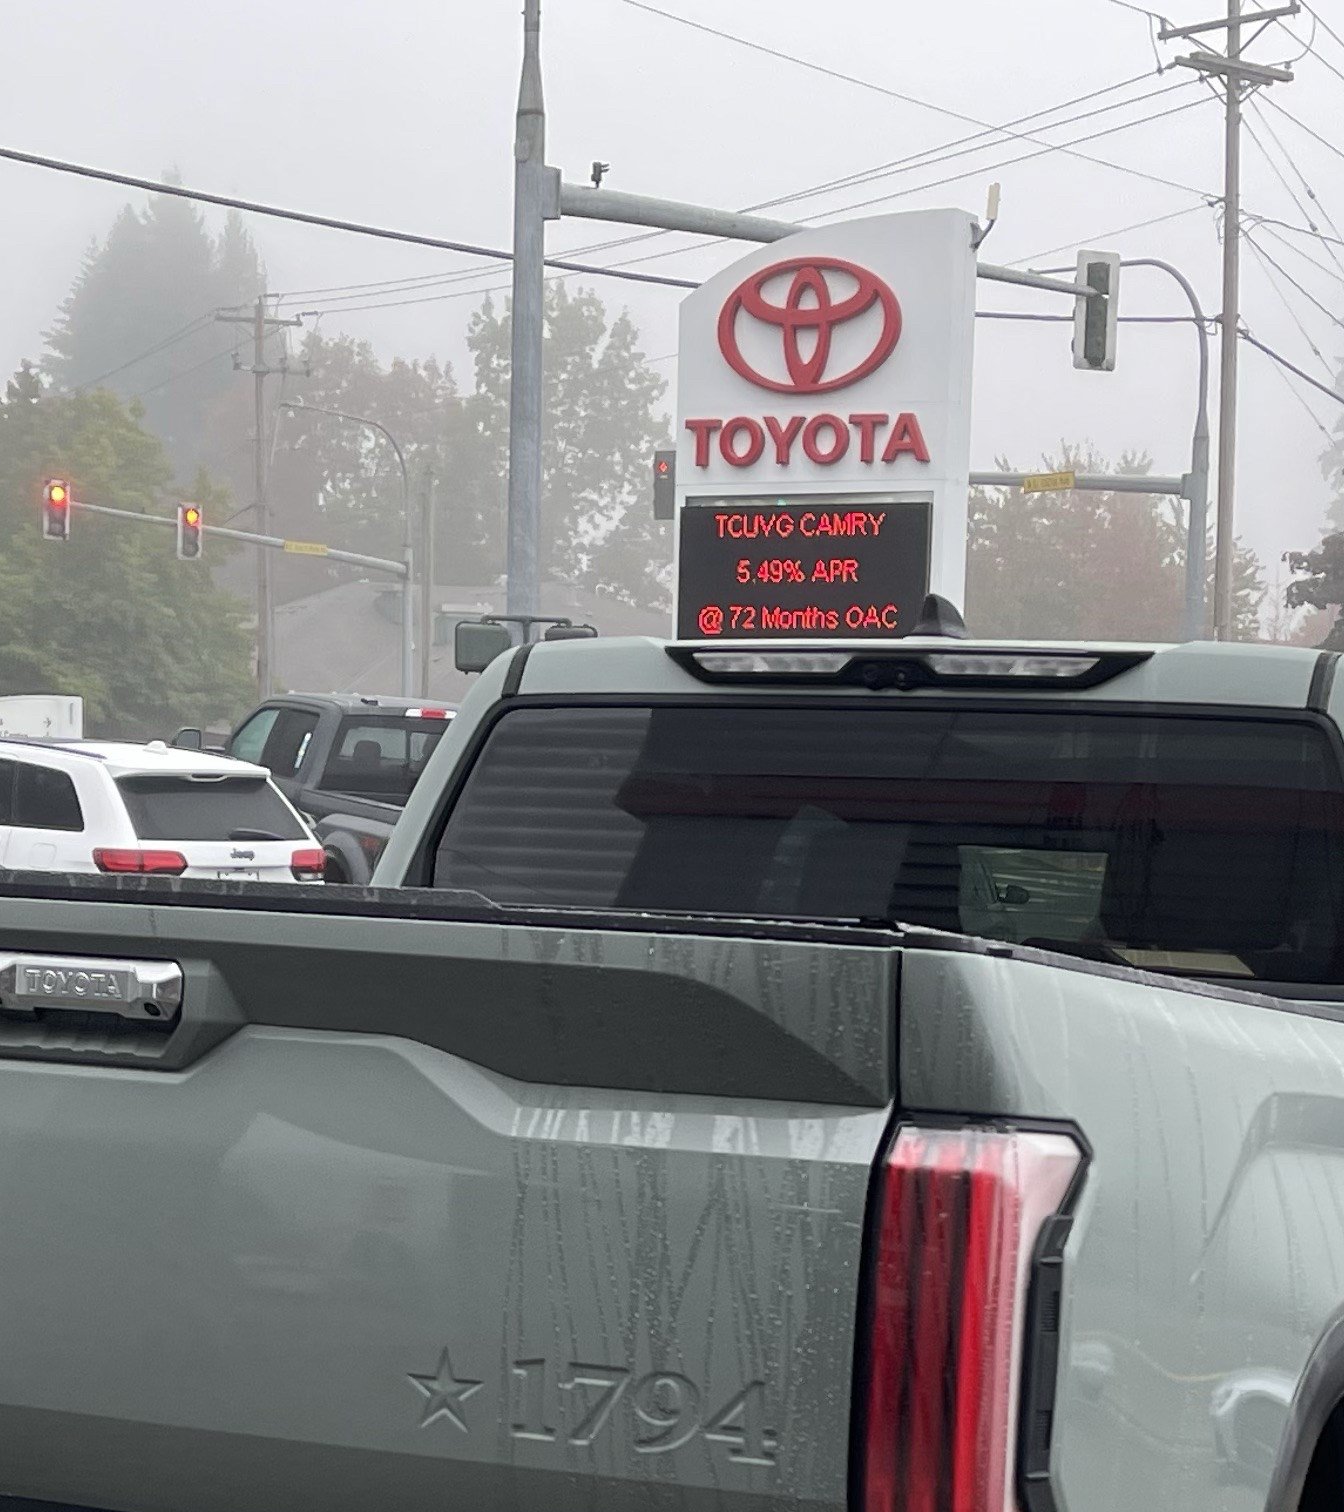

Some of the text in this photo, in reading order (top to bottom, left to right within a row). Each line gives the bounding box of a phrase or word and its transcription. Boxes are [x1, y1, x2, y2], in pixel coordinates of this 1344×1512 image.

[685, 412, 931, 468] TOYOTA
[715, 512, 886, 538] TCUVG CAMRY
[736, 559, 859, 584] 5.49% APR
[698, 604, 897, 634] @ 72 Months OAC
[24, 968, 123, 999] TOYOTA
[511, 1357, 778, 1467] 1794
